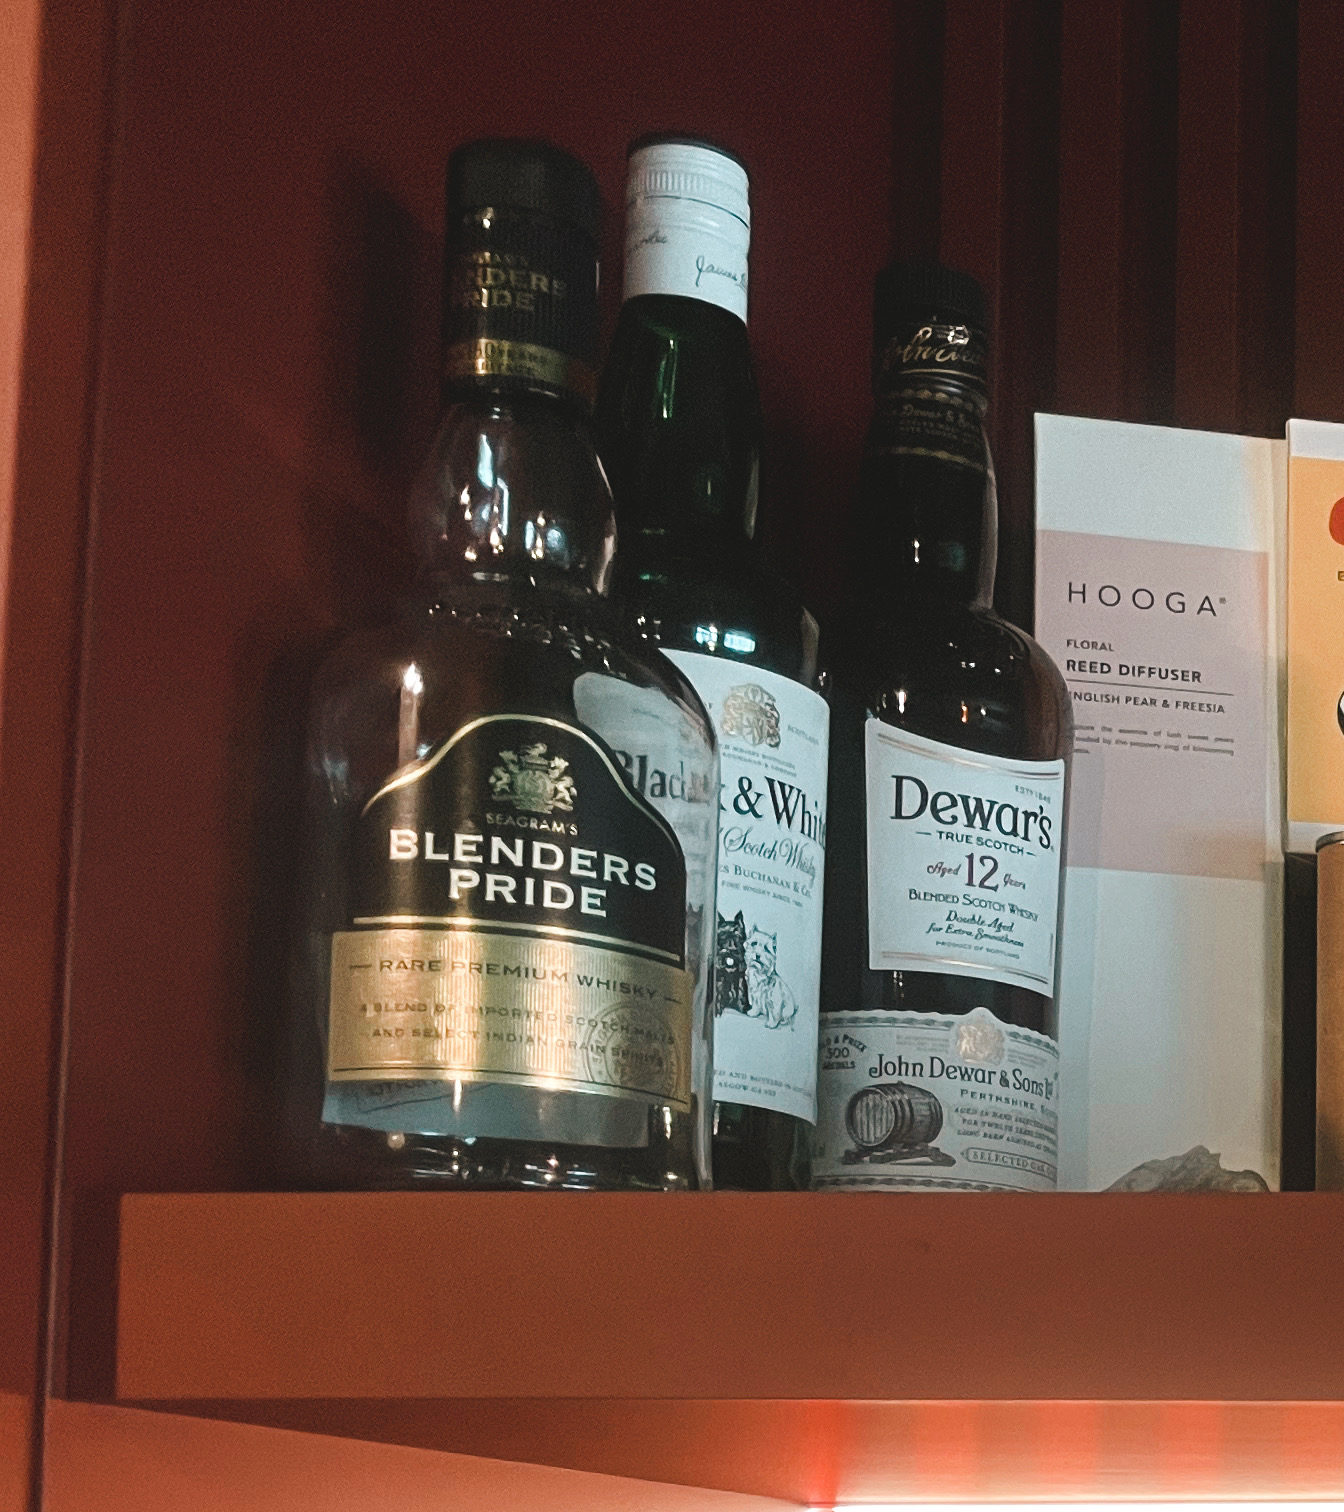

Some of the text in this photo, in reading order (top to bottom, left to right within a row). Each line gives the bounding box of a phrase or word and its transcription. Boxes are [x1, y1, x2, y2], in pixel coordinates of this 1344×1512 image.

[1066, 638, 1115, 652] FLORAL
[1066, 659, 1202, 684] REED DIFFUSER
[1125, 696, 1157, 708] PEAR
[1161, 699, 1170, 708] &
[1175, 701, 1226, 714] FREESIA
[485, 812, 579, 836] SEAGRAM'S
[733, 776, 763, 819] &
[764, 776, 827, 850] White
[890, 774, 1052, 850] Dewar's
[936, 830, 1024, 857] TRUE SCOTCH
[389, 829, 657, 892] BLENDERS
[927, 861, 962, 878] Aged
[965, 852, 999, 893] 12
[733, 864, 791, 890] BUCHANAN
[449, 868, 608, 918] PRIDE
[925, 922, 943, 934] for
[945, 910, 986, 926] Double
[380, 958, 659, 1000] RARE PREMIUM WHISKY
[373, 1002, 428, 1014] BLEND
[565, 1014, 629, 1032] SCOTCH
[371, 1027, 404, 1039] AND
[411, 1028, 479, 1042] SELECT
[486, 1032, 549, 1049] INDIAN
[868, 1053, 924, 1079] John
[929, 1056, 997, 1085] Dewar
[999, 1070, 1010, 1088] &
[1012, 1068, 1044, 1098] Sons
